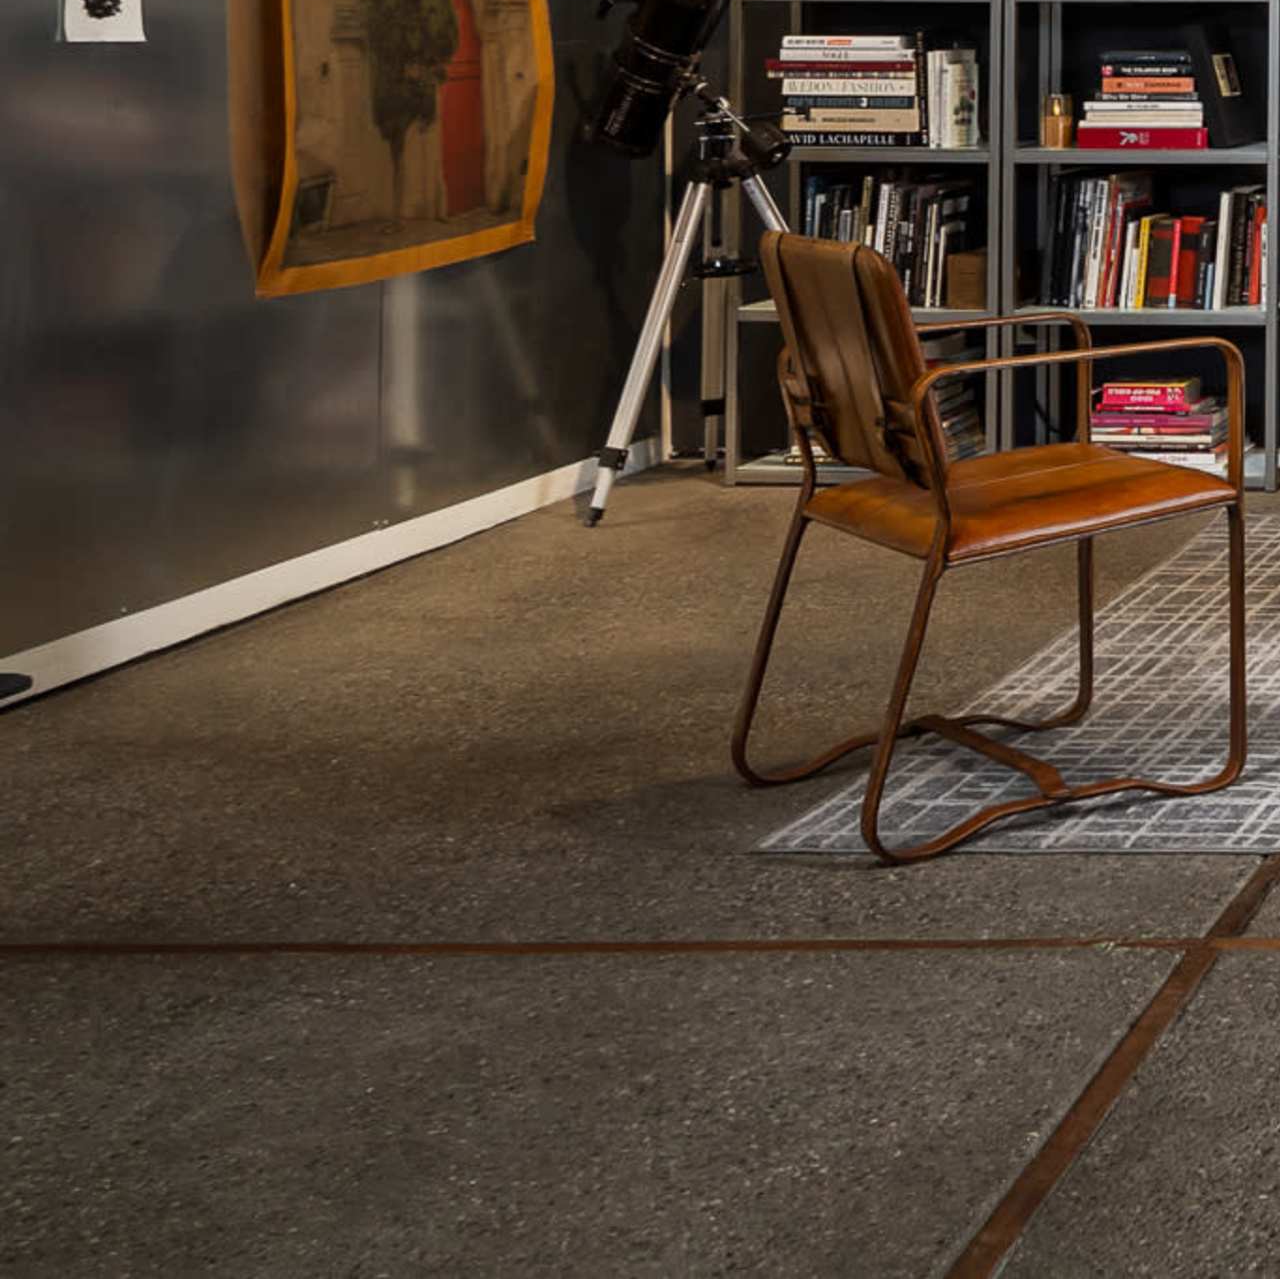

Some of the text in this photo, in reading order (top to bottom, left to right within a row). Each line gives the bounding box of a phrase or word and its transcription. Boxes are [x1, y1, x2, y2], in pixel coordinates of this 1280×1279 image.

[841, 79, 895, 93] FASHION
[785, 134, 896, 144] AVID LACHAPELLE
